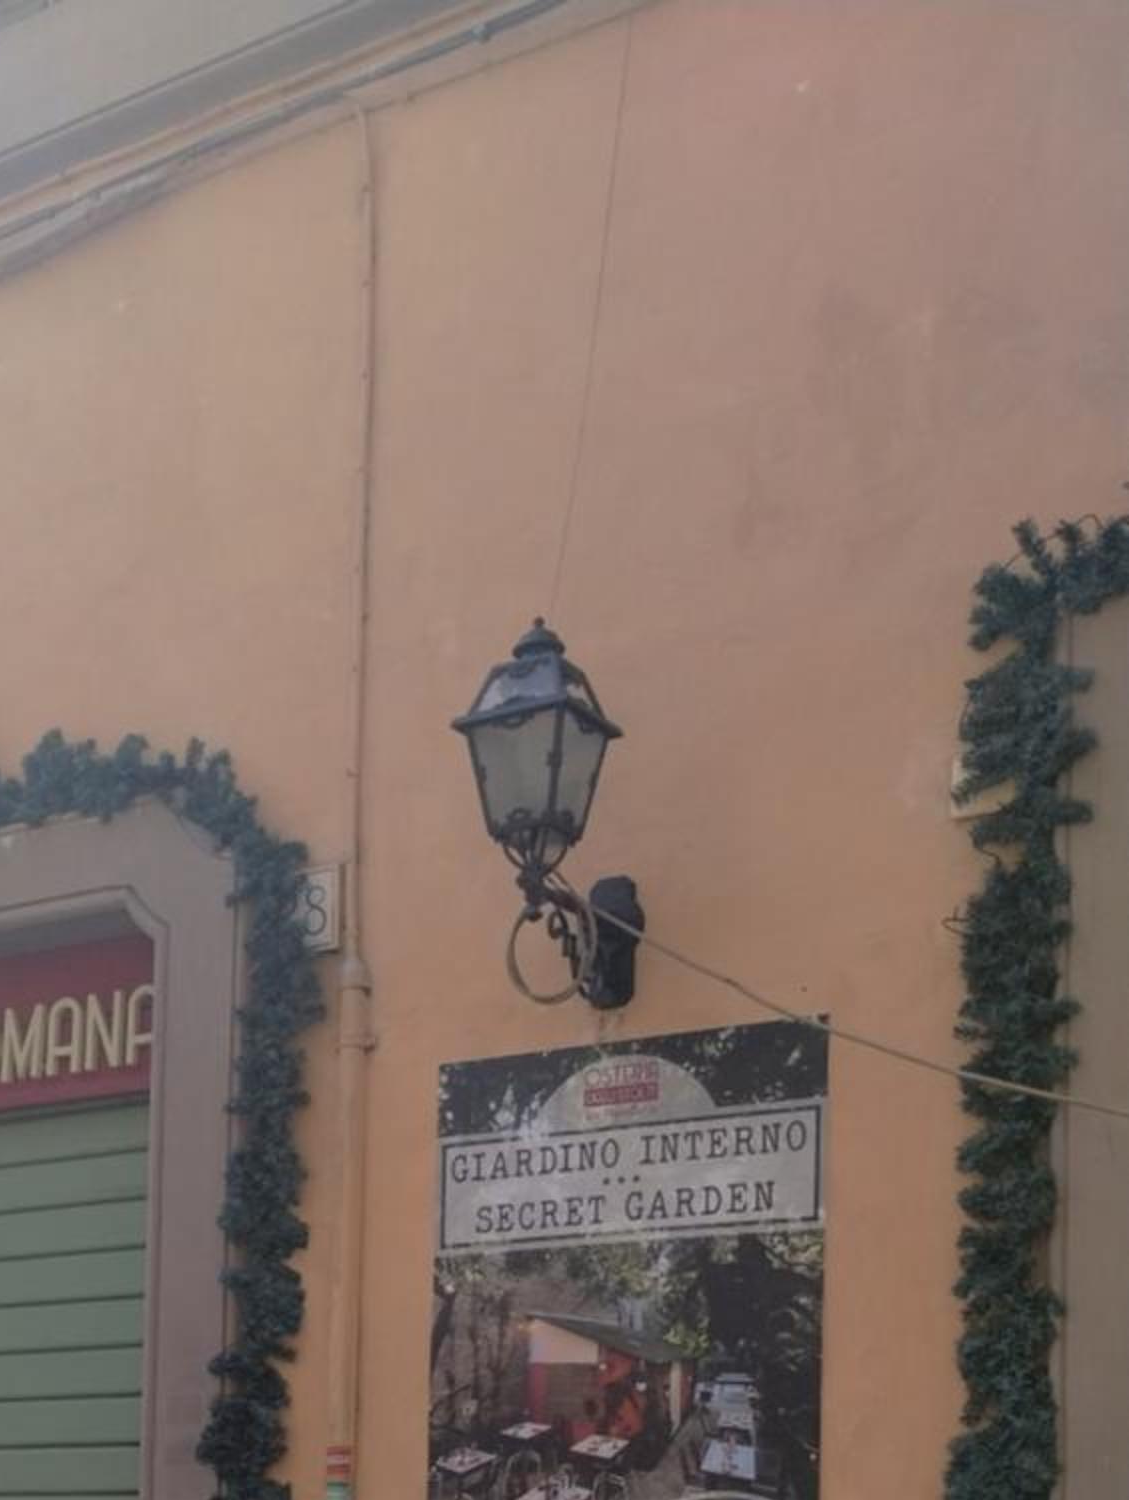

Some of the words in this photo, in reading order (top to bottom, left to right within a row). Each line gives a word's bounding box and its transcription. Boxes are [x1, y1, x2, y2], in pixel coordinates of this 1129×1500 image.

[450, 1138, 621, 1184] GIARDINO
[639, 1120, 808, 1166] INTERNO
[475, 1196, 607, 1235] SECRET
[624, 1181, 776, 1222] GARDEN
